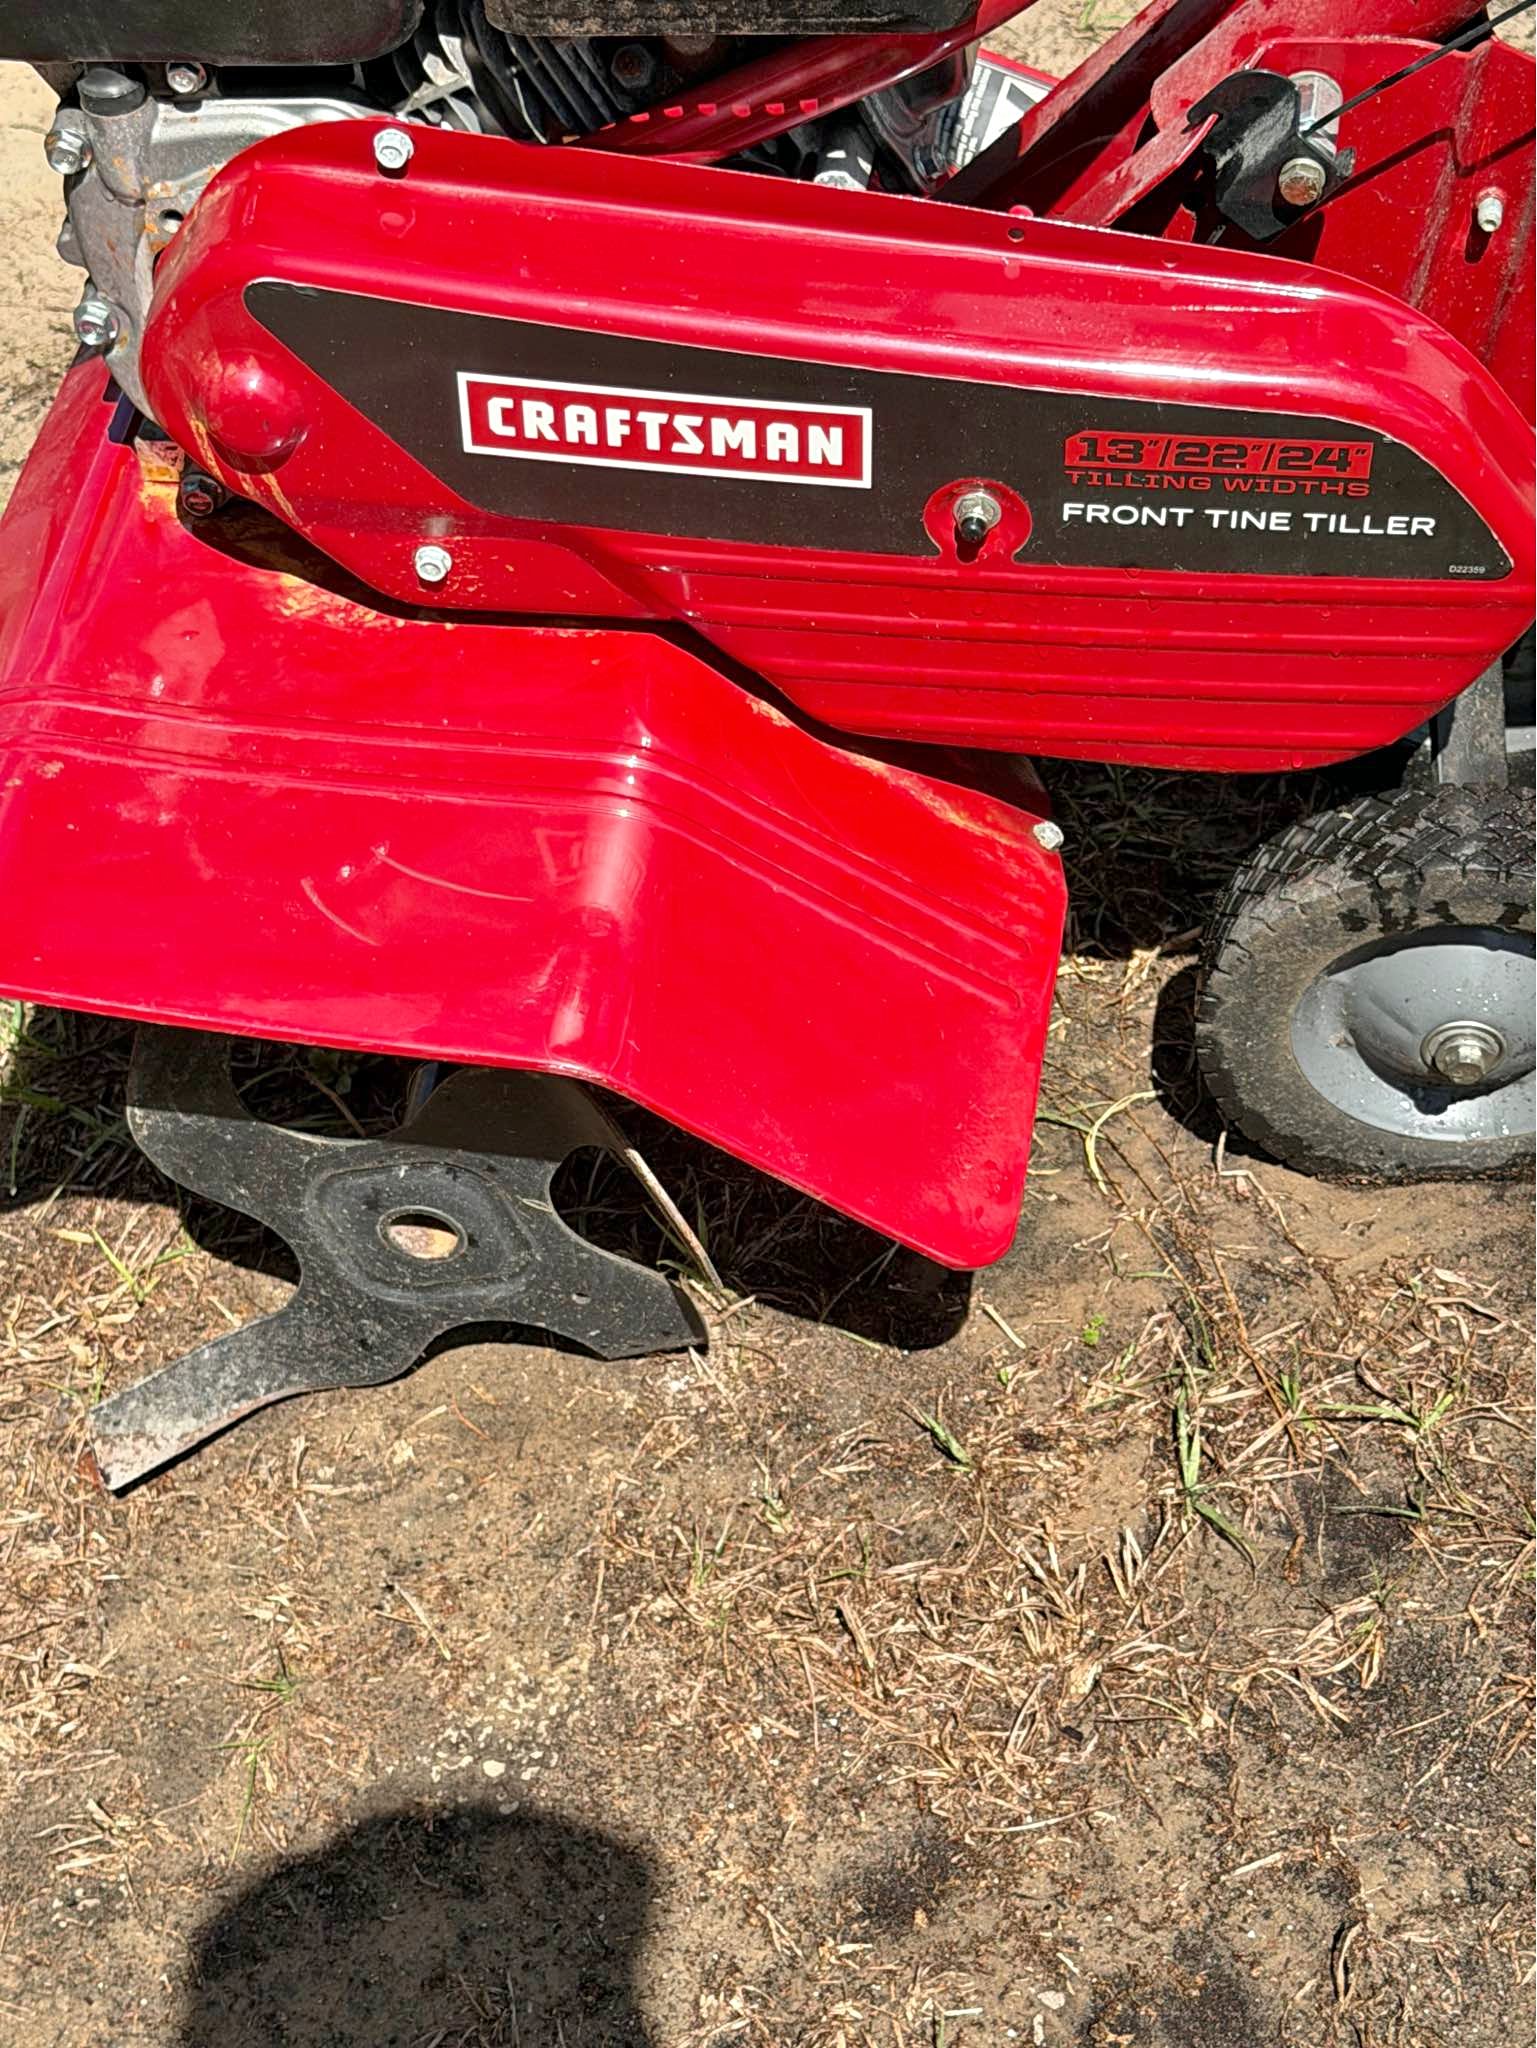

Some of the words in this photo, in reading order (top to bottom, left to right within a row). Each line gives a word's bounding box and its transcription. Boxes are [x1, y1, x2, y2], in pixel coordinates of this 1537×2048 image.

[487, 396, 843, 466] CRAFTSMAN
[1064, 470, 1212, 490] TILLING
[1223, 477, 1370, 497] WIDTHS
[1062, 502, 1194, 528] FRONT
[1204, 508, 1292, 532] TINE
[1303, 512, 1436, 537] TILLER
[1448, 565, 1486, 574] D22359
